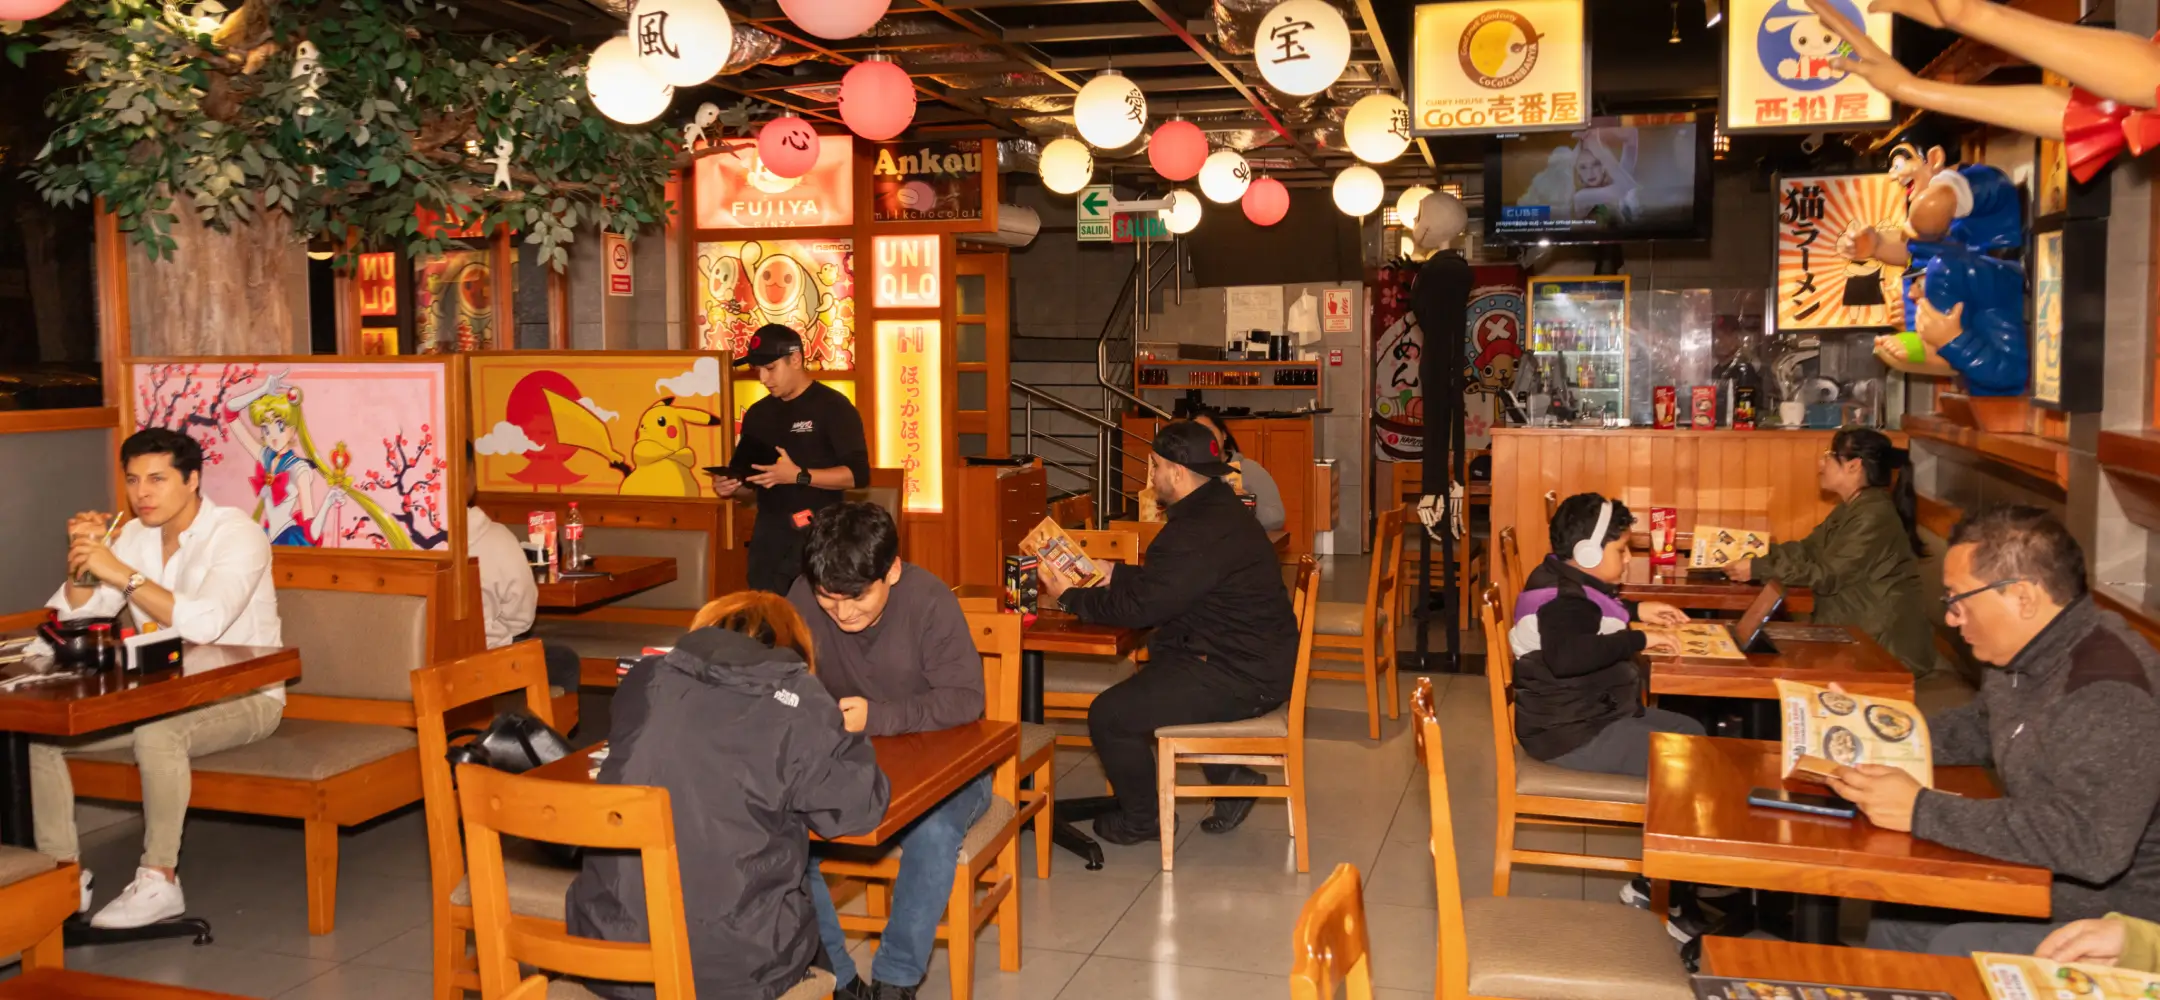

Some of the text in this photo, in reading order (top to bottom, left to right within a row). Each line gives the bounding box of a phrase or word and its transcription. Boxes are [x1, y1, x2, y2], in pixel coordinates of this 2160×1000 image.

[638, 11, 681, 59] 風
[1270, 16, 1315, 64] 宝
[1125, 88, 1146, 124] 愛
[1755, 93, 1869, 125] 西松屋
[782, 131, 810, 151] 心
[873, 147, 982, 176] Ankou
[732, 200, 819, 219] FUJIYA
[1081, 225, 1109, 235] SALIDA
[1116, 218, 1168, 238] SALIDA
[880, 240, 931, 268] UNI
[1779, 186, 1825, 321] 猫ラーメン
[880, 273, 937, 304] QLO
